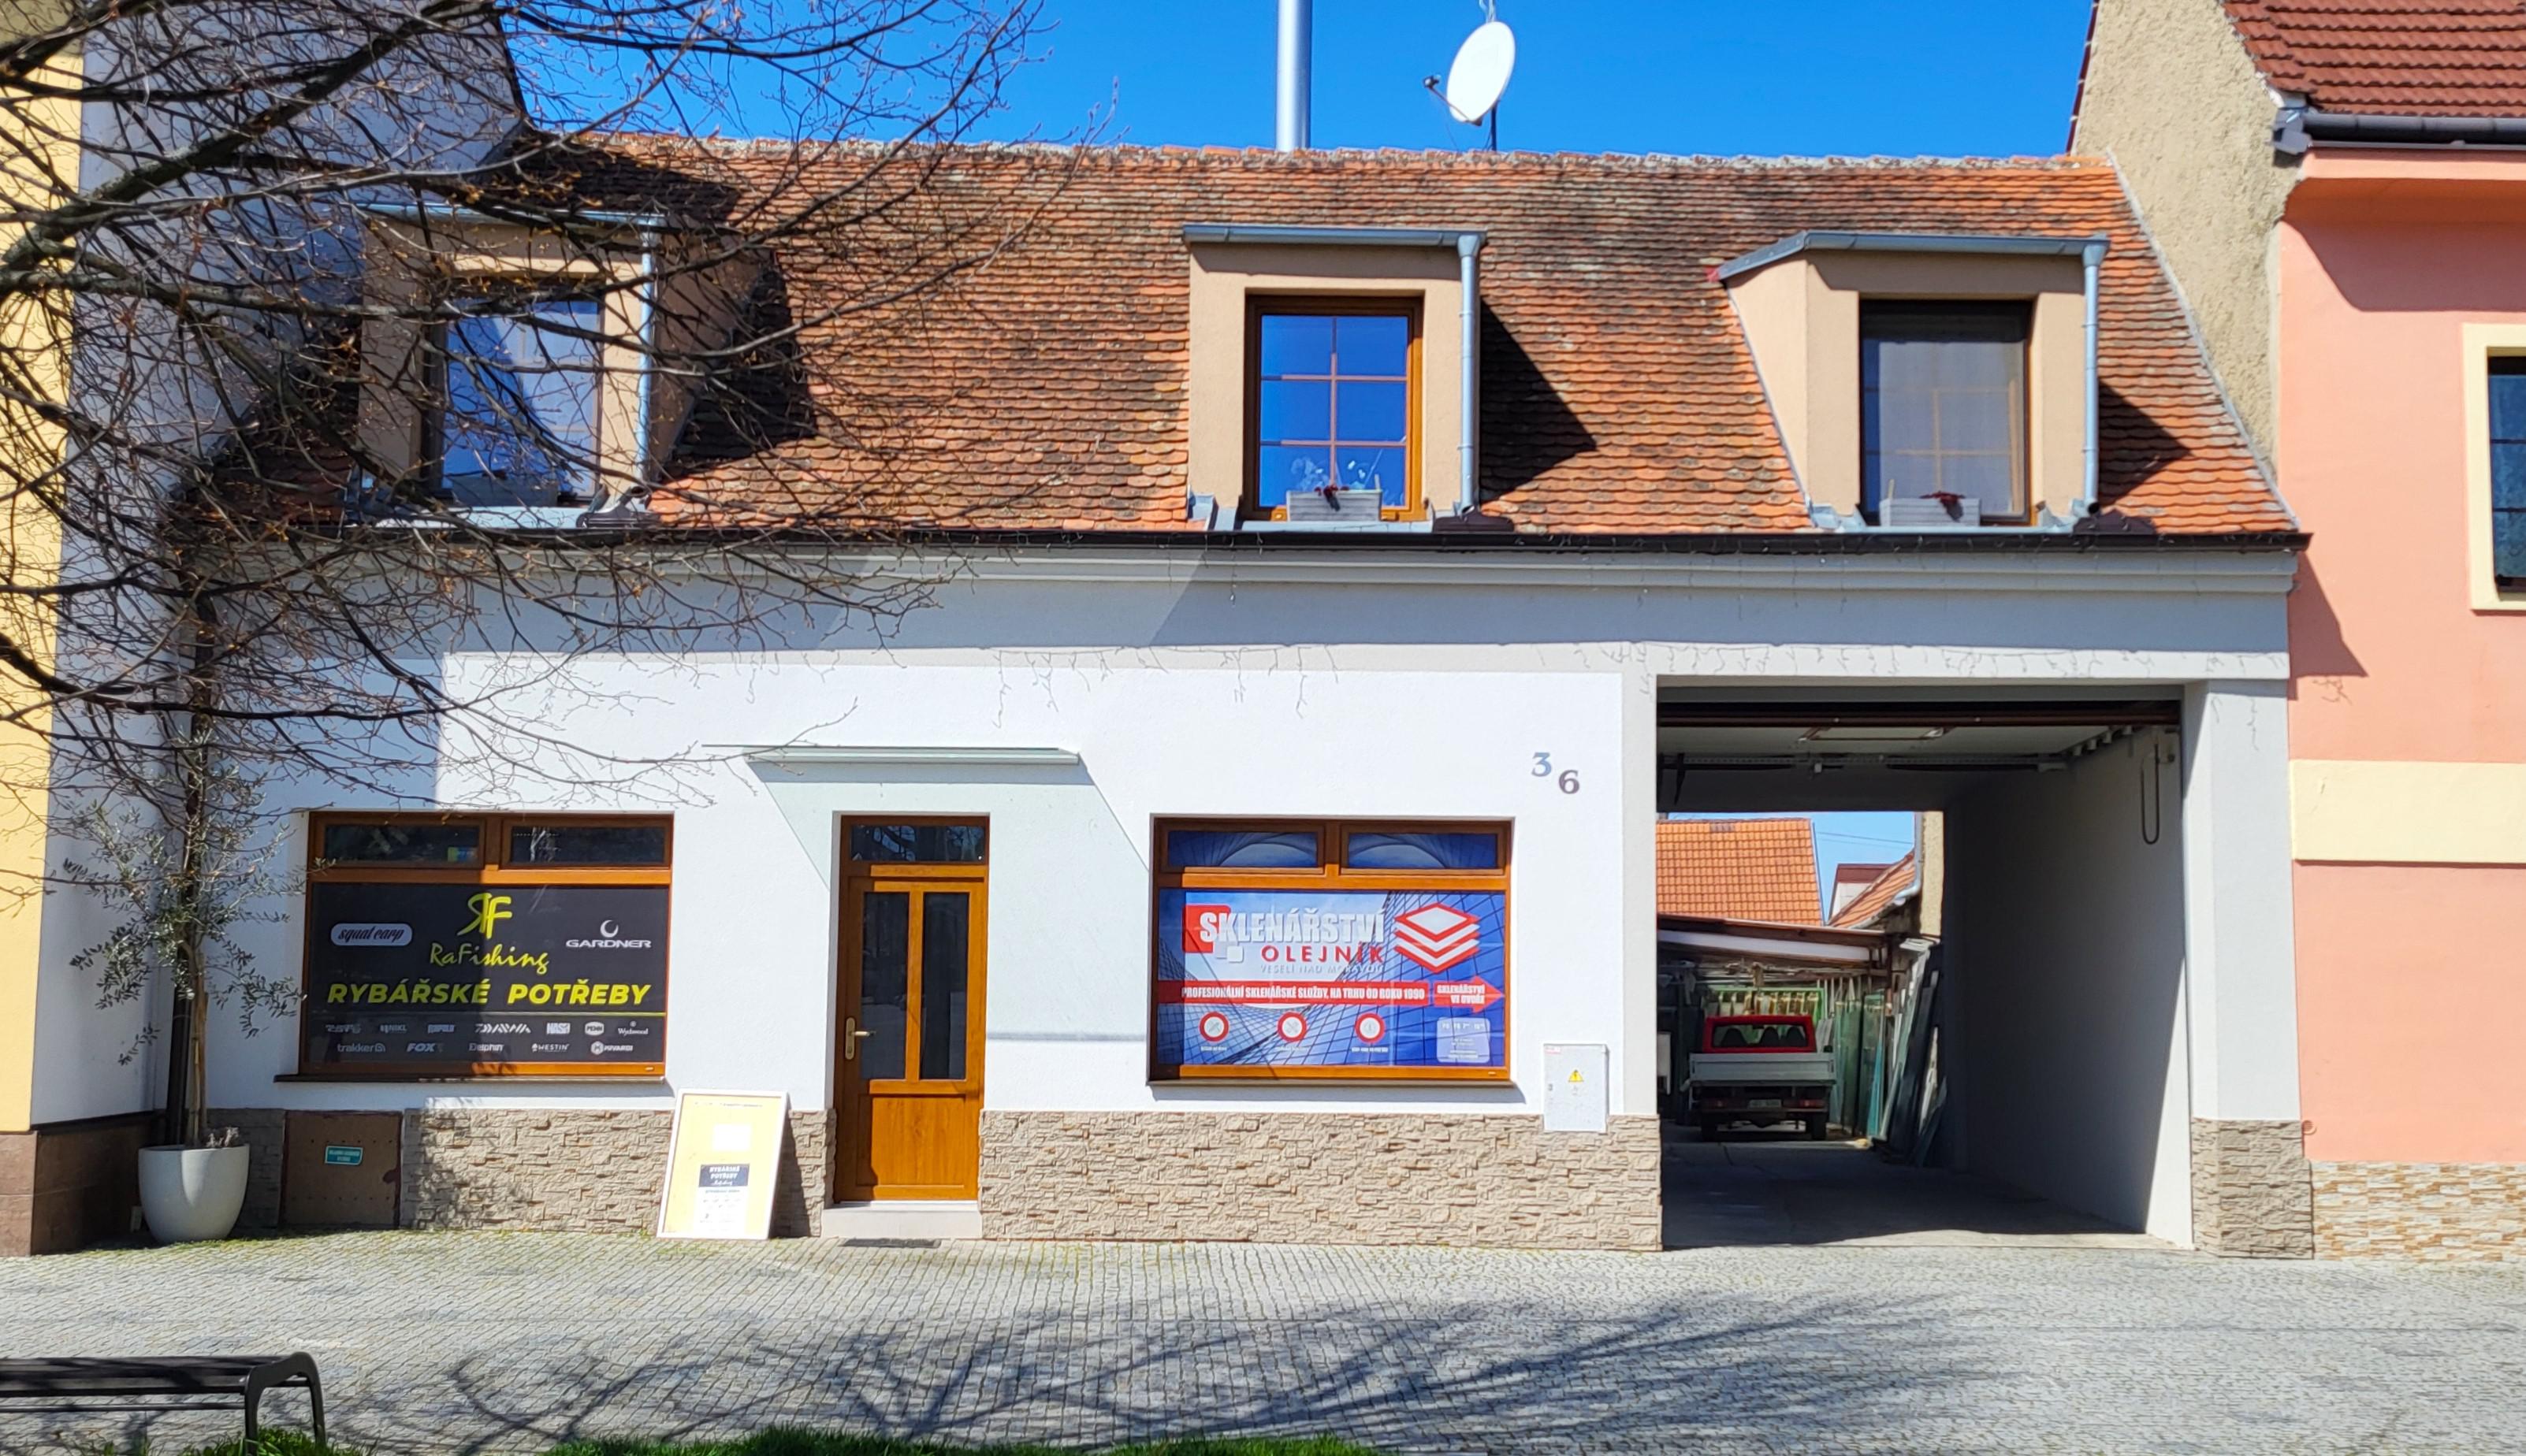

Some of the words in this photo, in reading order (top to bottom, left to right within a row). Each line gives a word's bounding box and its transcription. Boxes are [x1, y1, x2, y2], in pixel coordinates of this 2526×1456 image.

[1531, 752, 1580, 794] 36
[337, 926, 376, 943] squat
[373, 928, 405, 943] carp
[1200, 908, 1386, 944] SKLENÁŘSTVÍ
[565, 939, 652, 949] GARDNER
[1261, 941, 1384, 963] OLEJNÍK
[430, 942, 549, 975] RaFishing
[327, 979, 492, 1004] RYBÁŘSKÉ
[507, 979, 652, 1005] POTŘEBY
[1182, 986, 1244, 998] PROFESIONÁLNÍ
[474, 1023, 532, 1034] DAIWA
[337, 1042, 374, 1053] trakker
[407, 1042, 436, 1053] FOX
